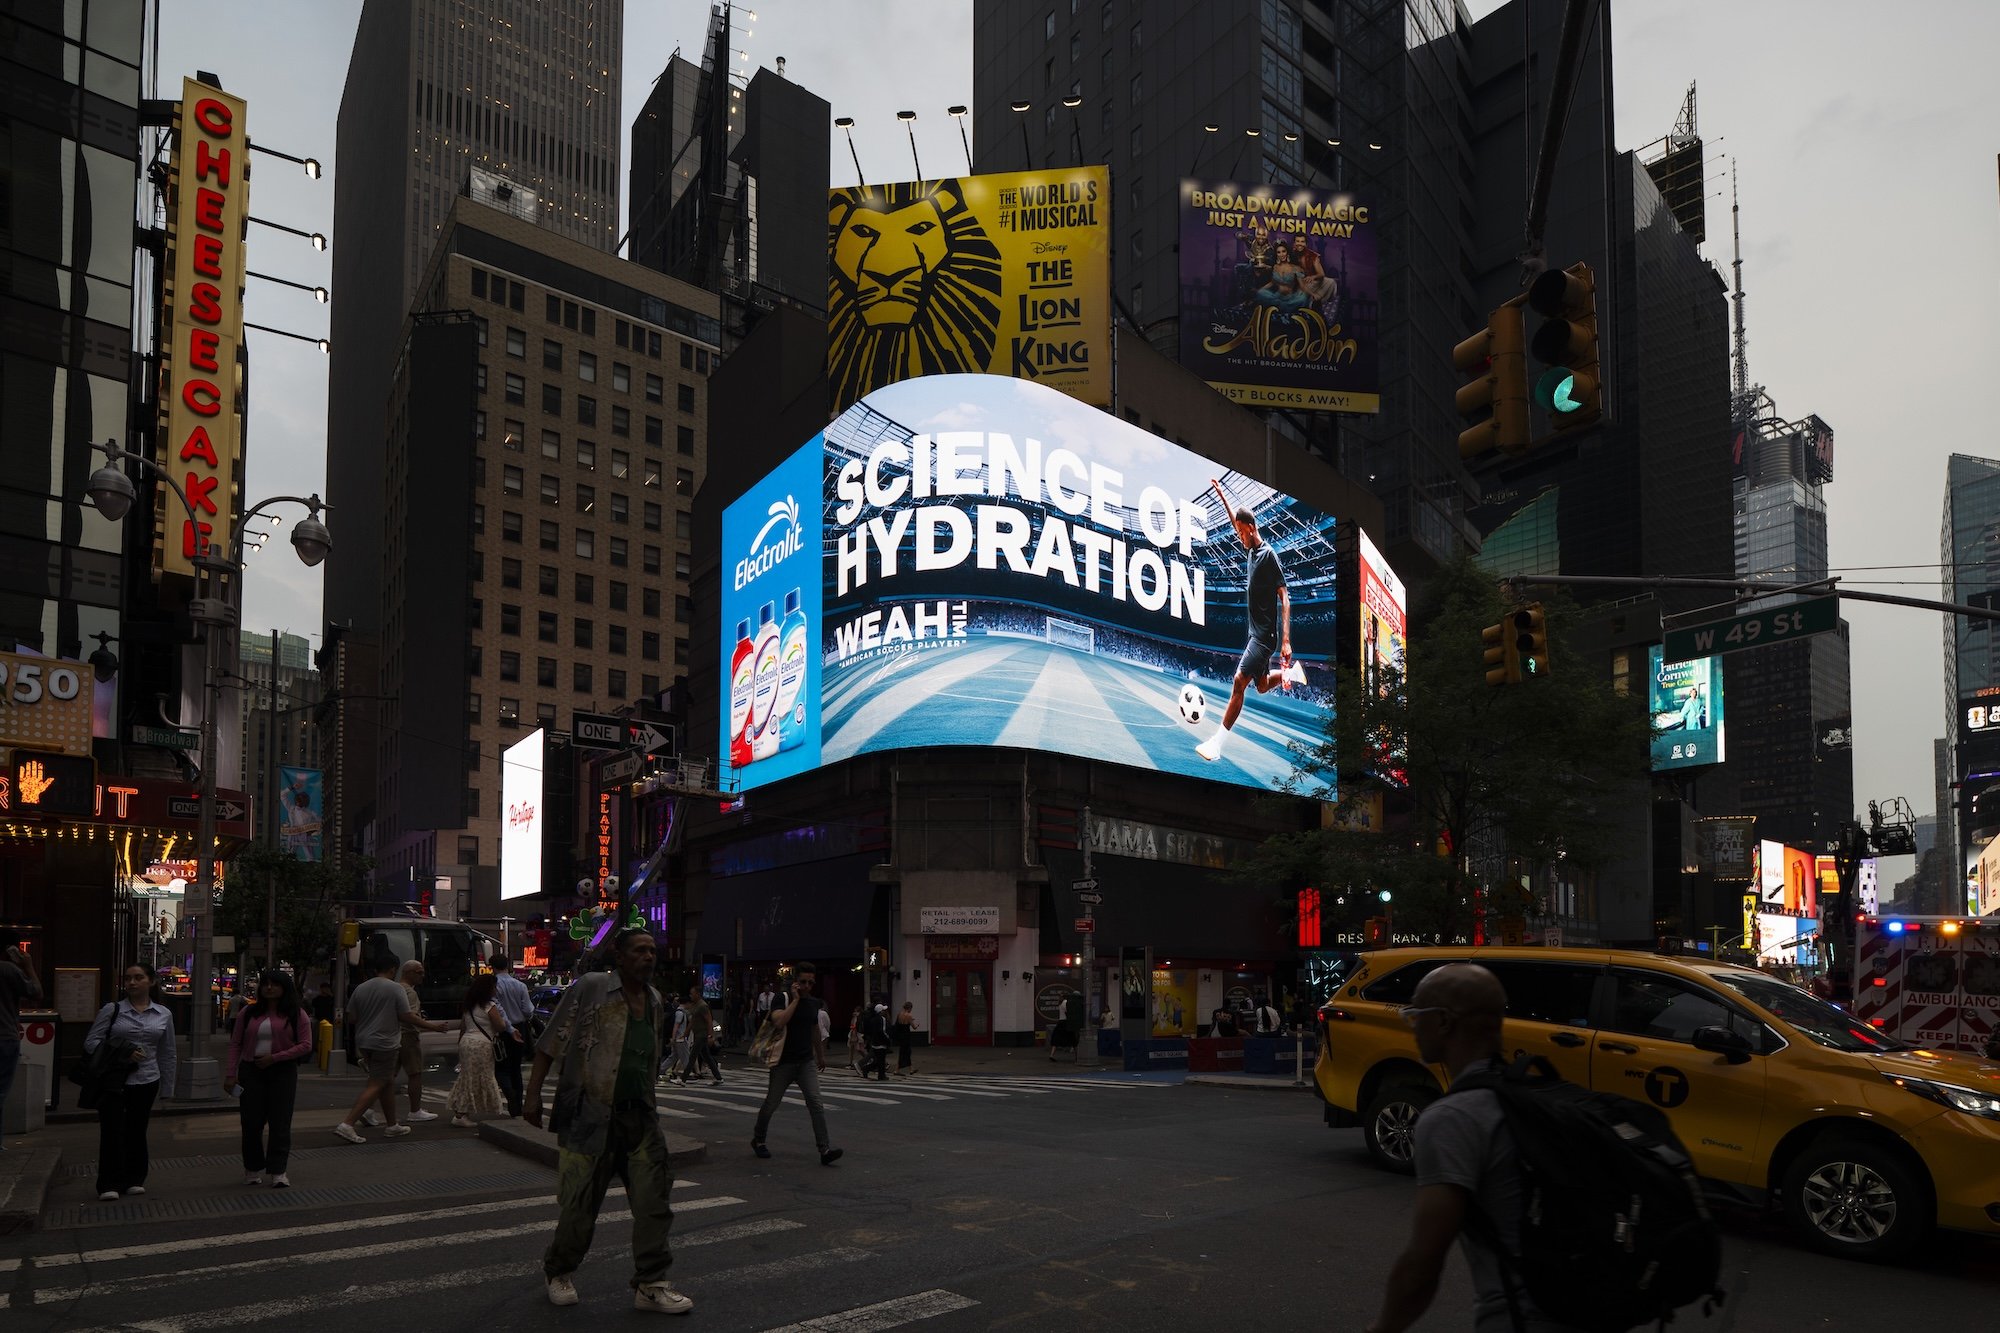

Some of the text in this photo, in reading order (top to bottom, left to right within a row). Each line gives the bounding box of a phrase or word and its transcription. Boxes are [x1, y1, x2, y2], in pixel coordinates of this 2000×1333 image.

[999, 180, 1097, 207] THE WORLD'S
[999, 203, 1098, 232] #1 MUSICAL
[1191, 190, 1369, 224] BROADWAY MAGIC
[1206, 210, 1355, 238] JUST A WISH AWAY
[1027, 259, 1073, 282] THE
[180, 97, 233, 559] CHEESECAKE
[1202, 304, 1359, 368] Aladdin
[1211, 322, 1238, 337] Disney
[1227, 357, 1339, 372] THE HIT BROADWAY MUSICAL
[1251, 390, 1302, 403] BLOCKS
[1308, 394, 1351, 407] AWAY!
[836, 431, 1207, 557] SCIENCE OF
[734, 522, 804, 592] Electrolit
[836, 504, 1206, 627] HYDRATION
[835, 601, 967, 661] WEAH TIM
[1694, 610, 1804, 651] W 49 St
[876, 641, 913, 656] SOCCER
[918, 639, 967, 650] PLAYER"
[147, 729, 200, 751] Broadway
[584, 724, 612, 740] ONE
[175, 803, 200, 814] ONE
[1090, 821, 1158, 857] MAMA
[180, 870, 197, 878] LO
[1508, 932, 1517, 943] 5
[1548, 938, 1559, 947] 10
[1907, 993, 2000, 1008] AMBULANC
[1916, 1031, 1990, 1043] KEEP BAC
[1624, 1070, 1645, 1079] NYC
